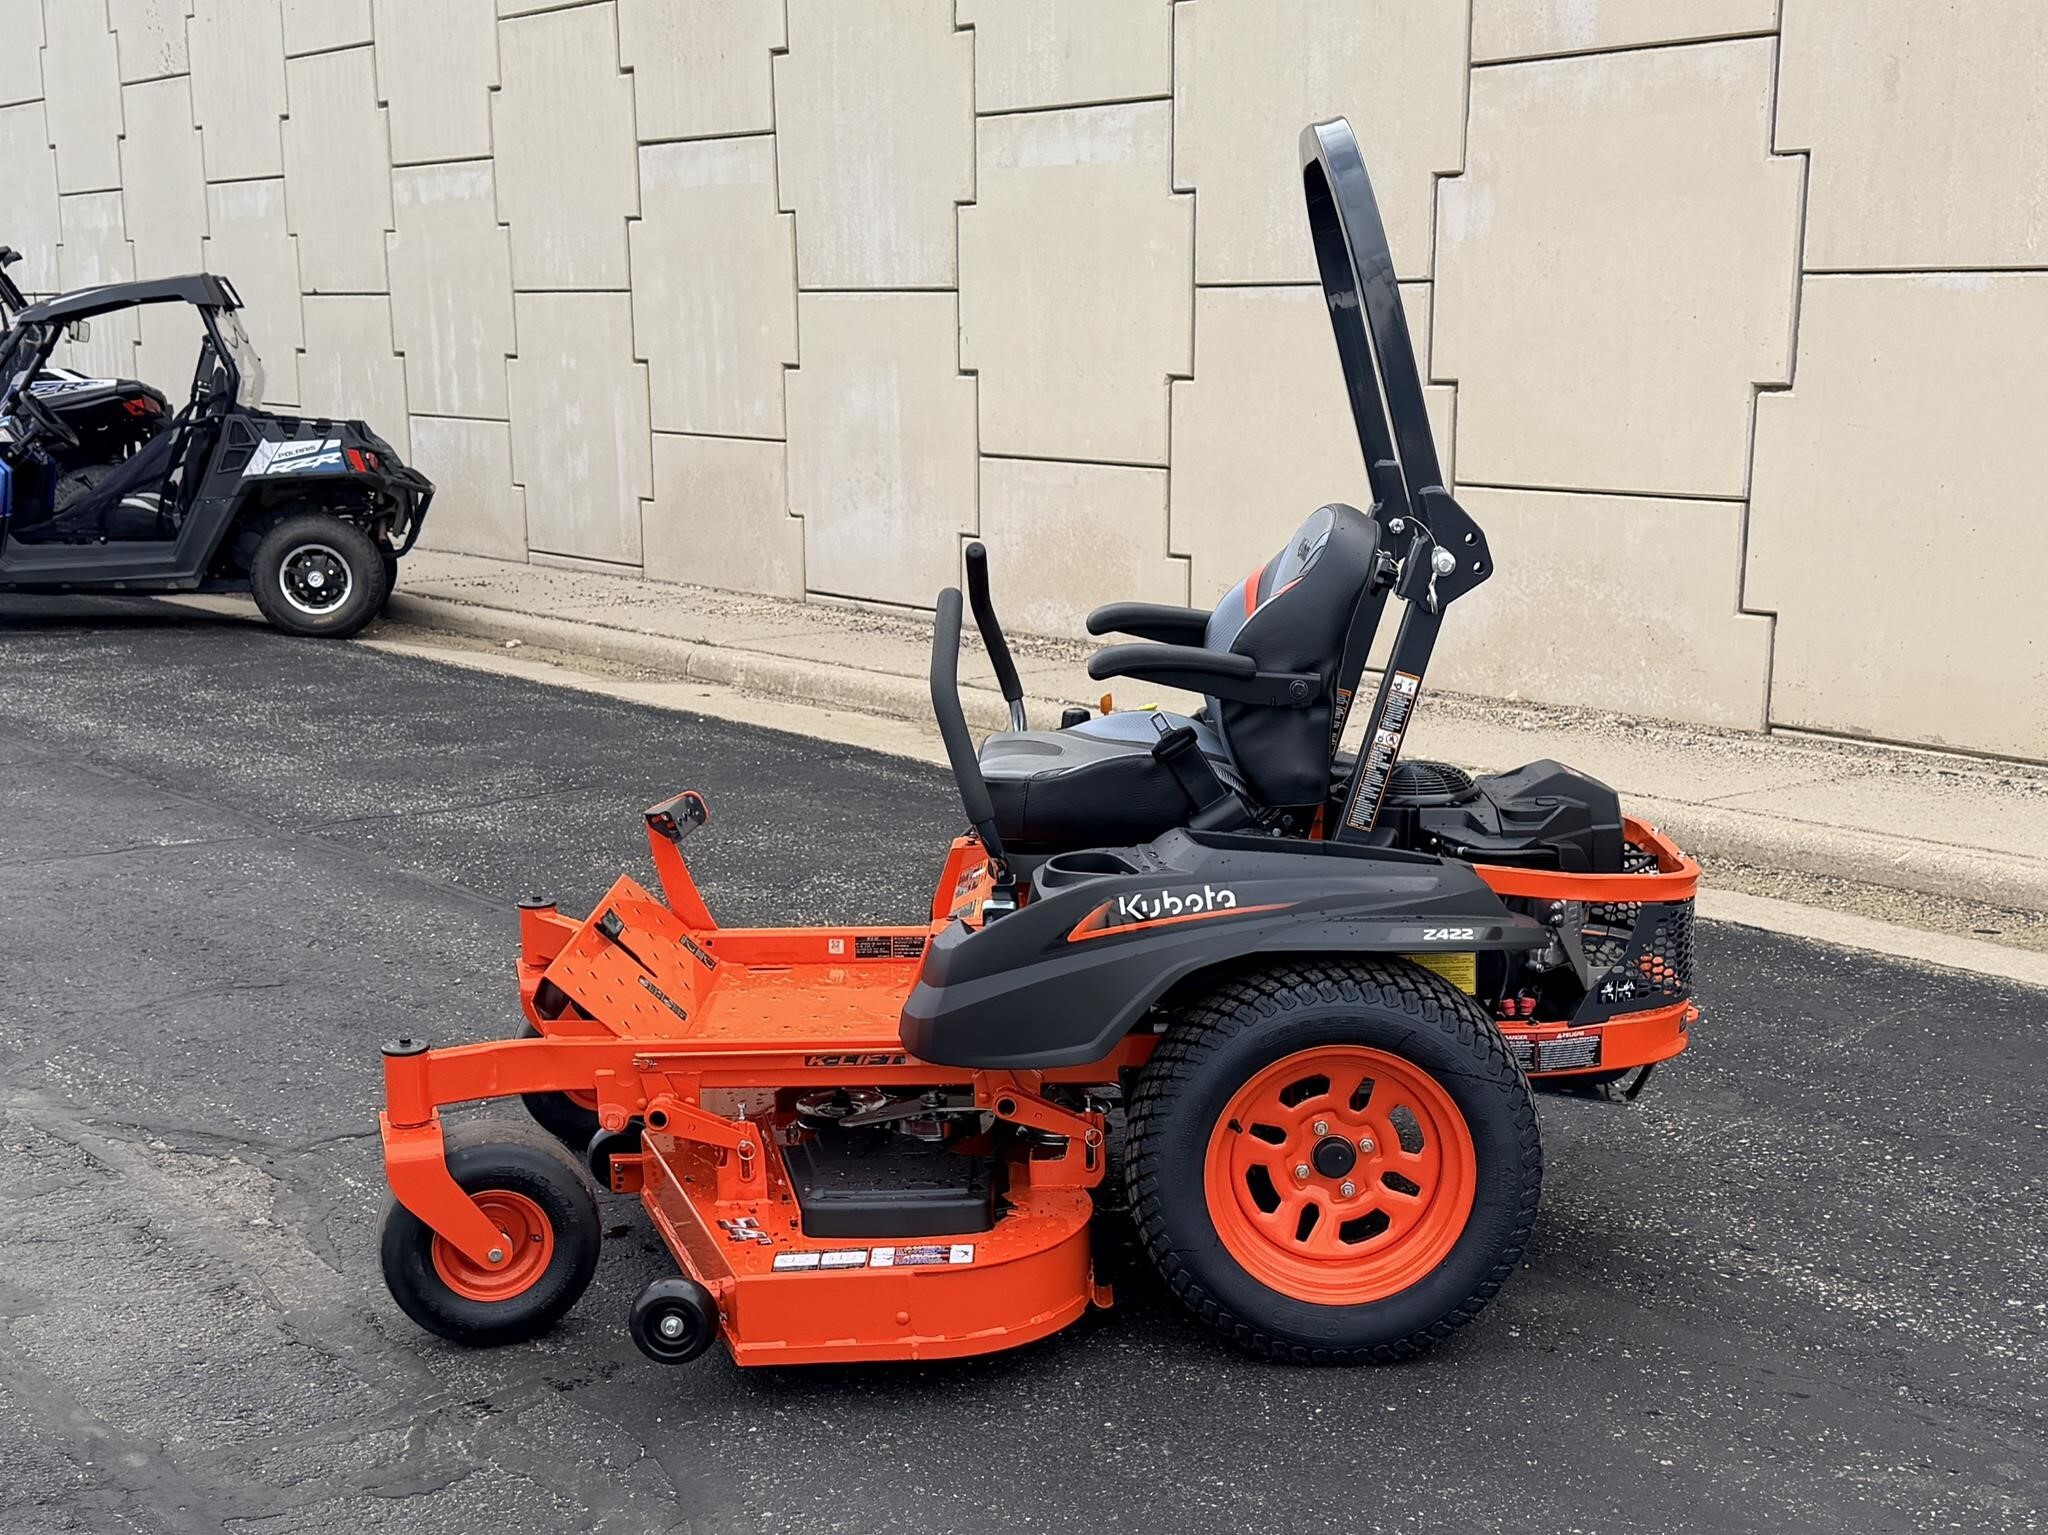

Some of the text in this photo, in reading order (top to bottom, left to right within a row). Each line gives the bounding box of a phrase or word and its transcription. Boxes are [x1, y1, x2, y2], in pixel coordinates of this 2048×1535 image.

[278, 445, 316, 458] POLARIS
[266, 452, 341, 474] RZR
[1118, 885, 1237, 919] Kubota
[1423, 928, 1474, 940] Z422
[807, 1054, 897, 1066] K-LIFT
